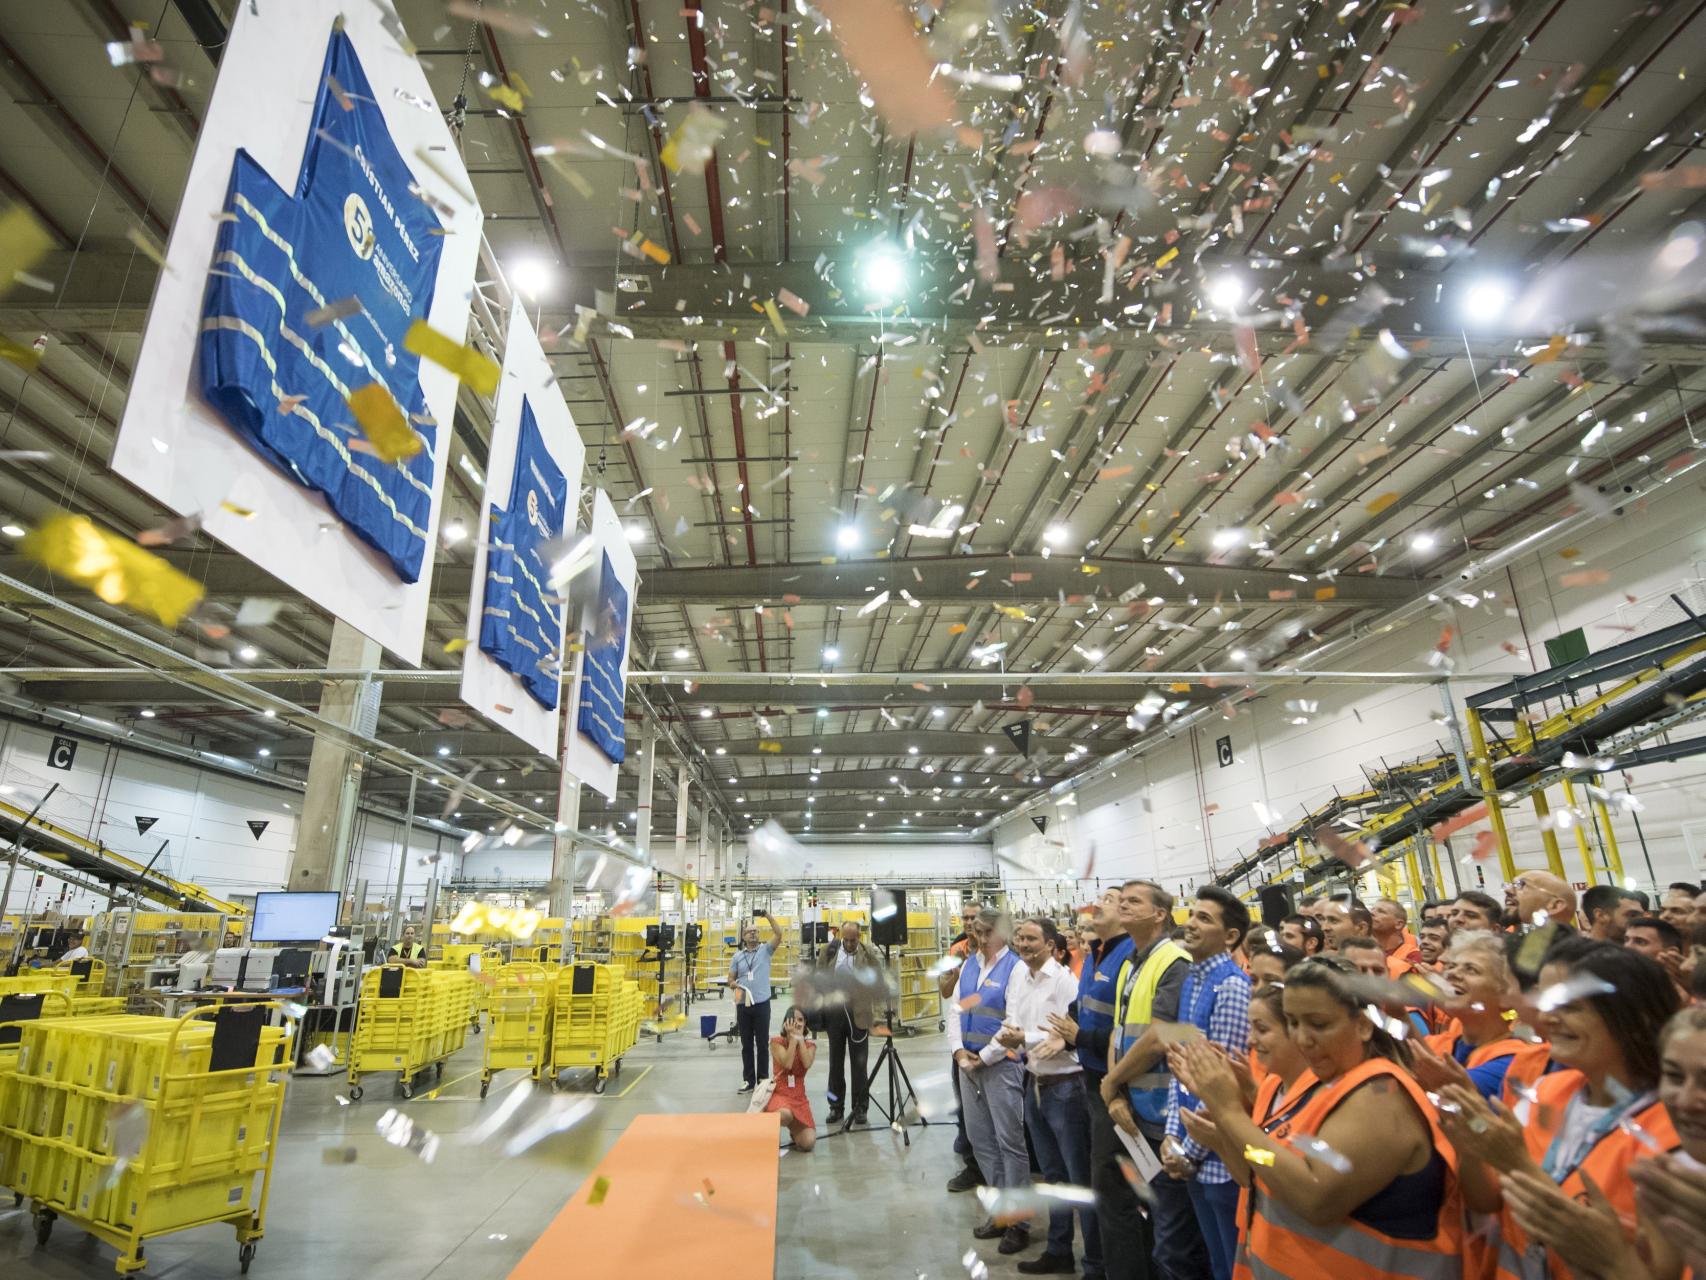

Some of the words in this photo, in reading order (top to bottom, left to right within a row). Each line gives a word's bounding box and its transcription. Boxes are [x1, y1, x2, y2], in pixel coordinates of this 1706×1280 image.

[355, 144, 394, 220] CRISTIAN
[54, 746, 70, 768] C
[1221, 745, 1230, 764] C
